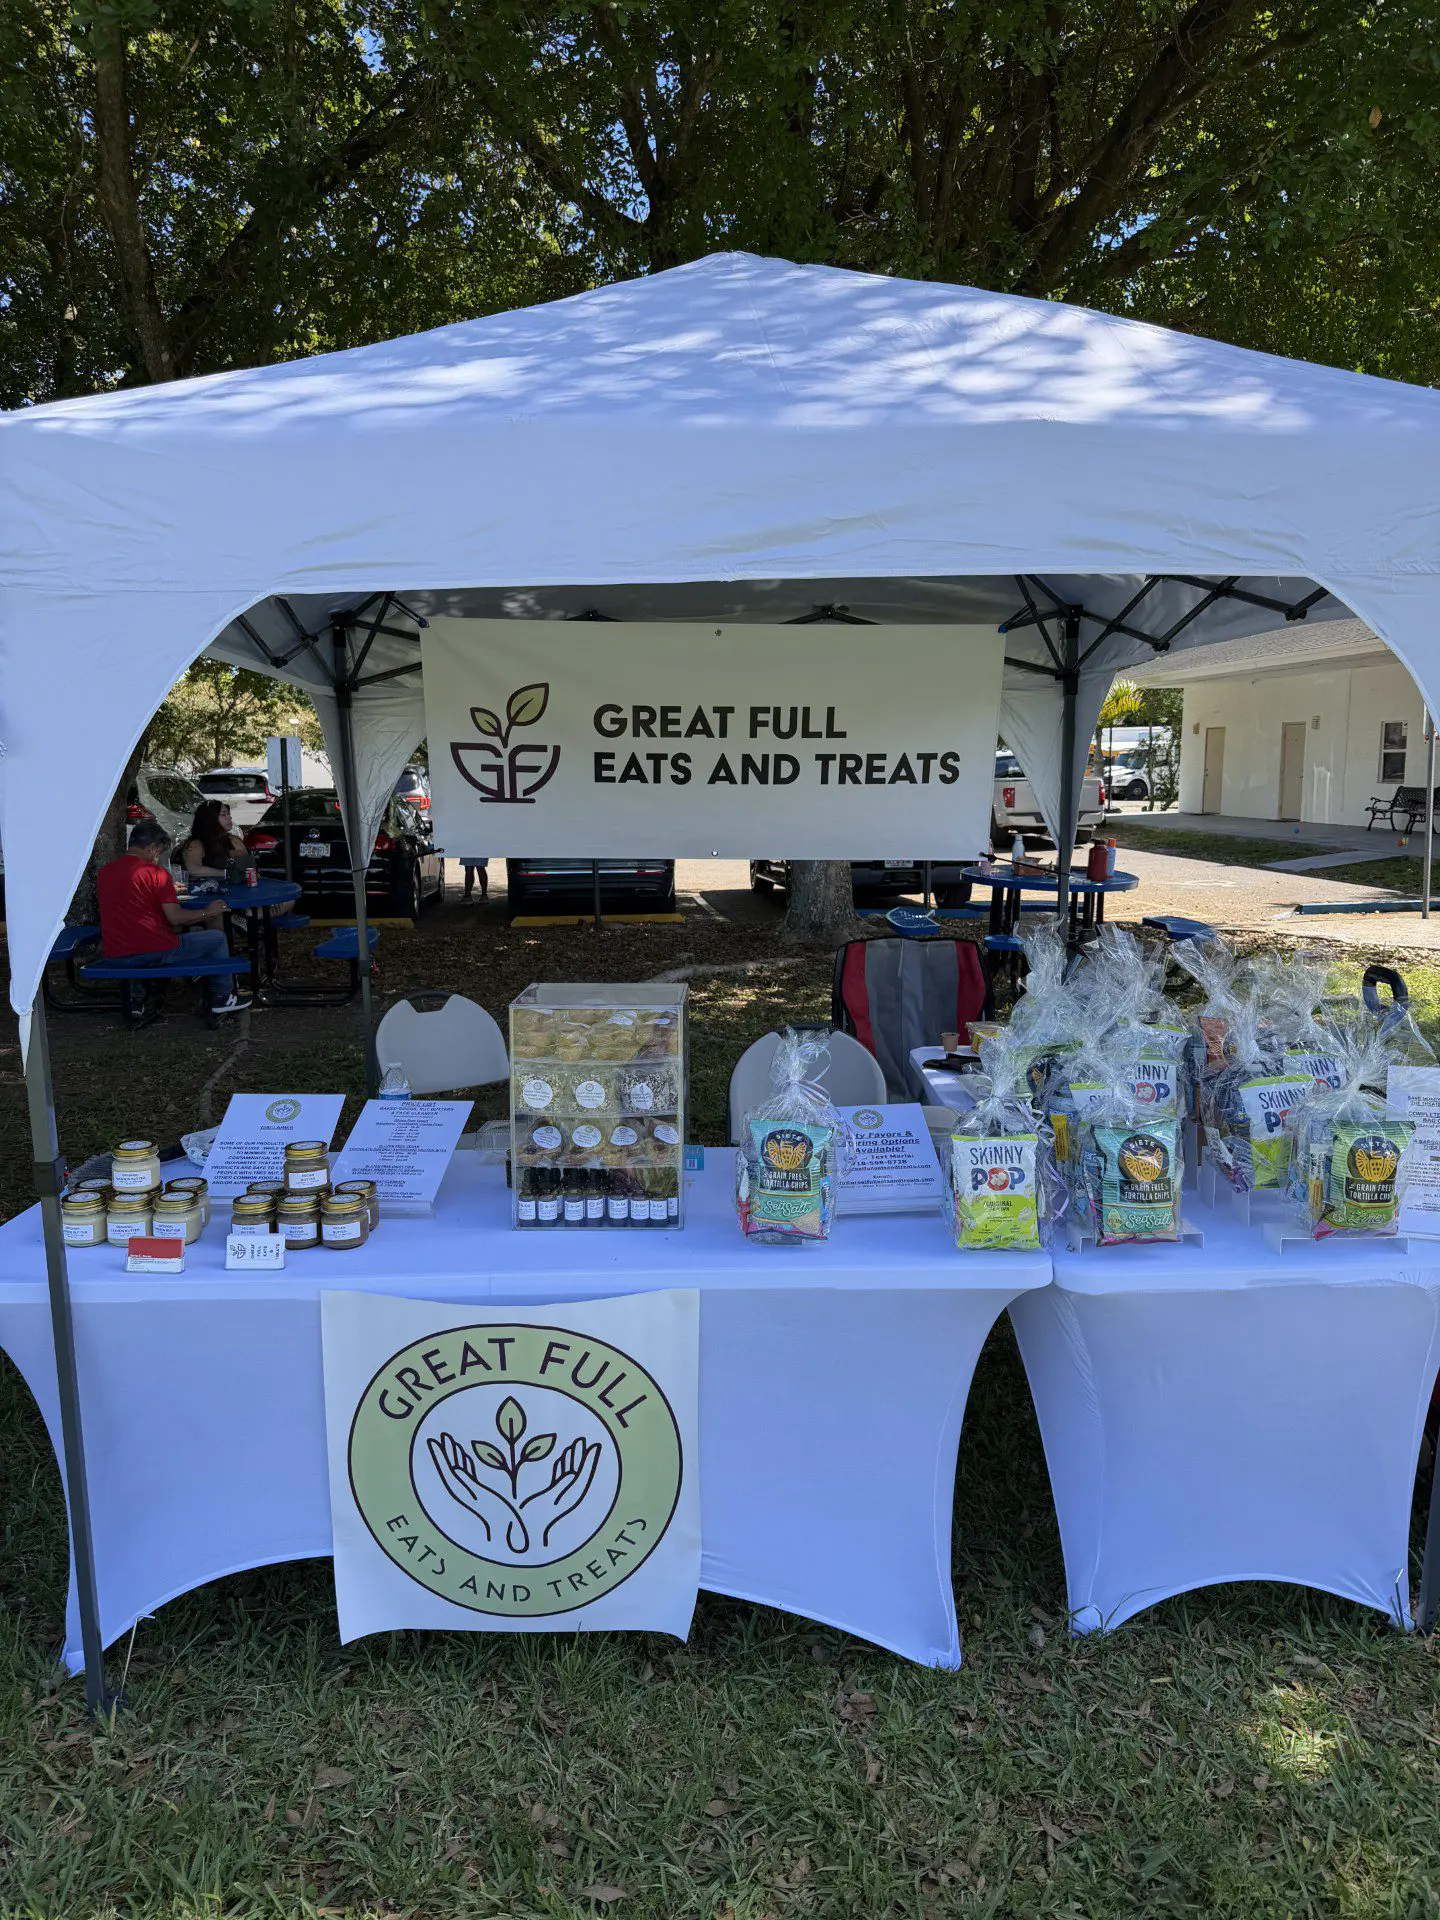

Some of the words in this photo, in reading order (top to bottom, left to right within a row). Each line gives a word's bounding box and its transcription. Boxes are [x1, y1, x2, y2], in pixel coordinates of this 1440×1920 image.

[593, 703, 735, 740] GREAT
[749, 706, 847, 740] FULL
[593, 751, 692, 786] EATS
[707, 753, 801, 786] AND
[815, 751, 961, 786] TREATS
[868, 1131, 902, 1139] Favors
[904, 1130, 914, 1138] &
[880, 1138, 921, 1146] Options
[1129, 1139, 1155, 1149] SIETE
[768, 1171, 787, 1180] GRAIN
[788, 1172, 803, 1181] FREE
[970, 1166, 1026, 1191] POP
[791, 1180, 808, 1189] CHIPS
[1151, 1183, 1165, 1191] FREE
[1356, 1183, 1376, 1192] GRAIN
[1125, 1191, 1153, 1200] TORTILLA
[1154, 1191, 1170, 1200] CHIPS
[1349, 1191, 1378, 1200] TORTILLA
[1379, 1192, 1391, 1200] CHI
[782, 1202, 811, 1216] Salt
[1125, 1213, 1149, 1229] Sea
[1146, 1212, 1173, 1228] Salt
[378, 1337, 516, 1420] GREAT
[538, 1341, 649, 1429] FULL
[386, 1513, 447, 1576] EATS
[459, 1574, 532, 1603] AND
[547, 1517, 648, 1599] TREATS
